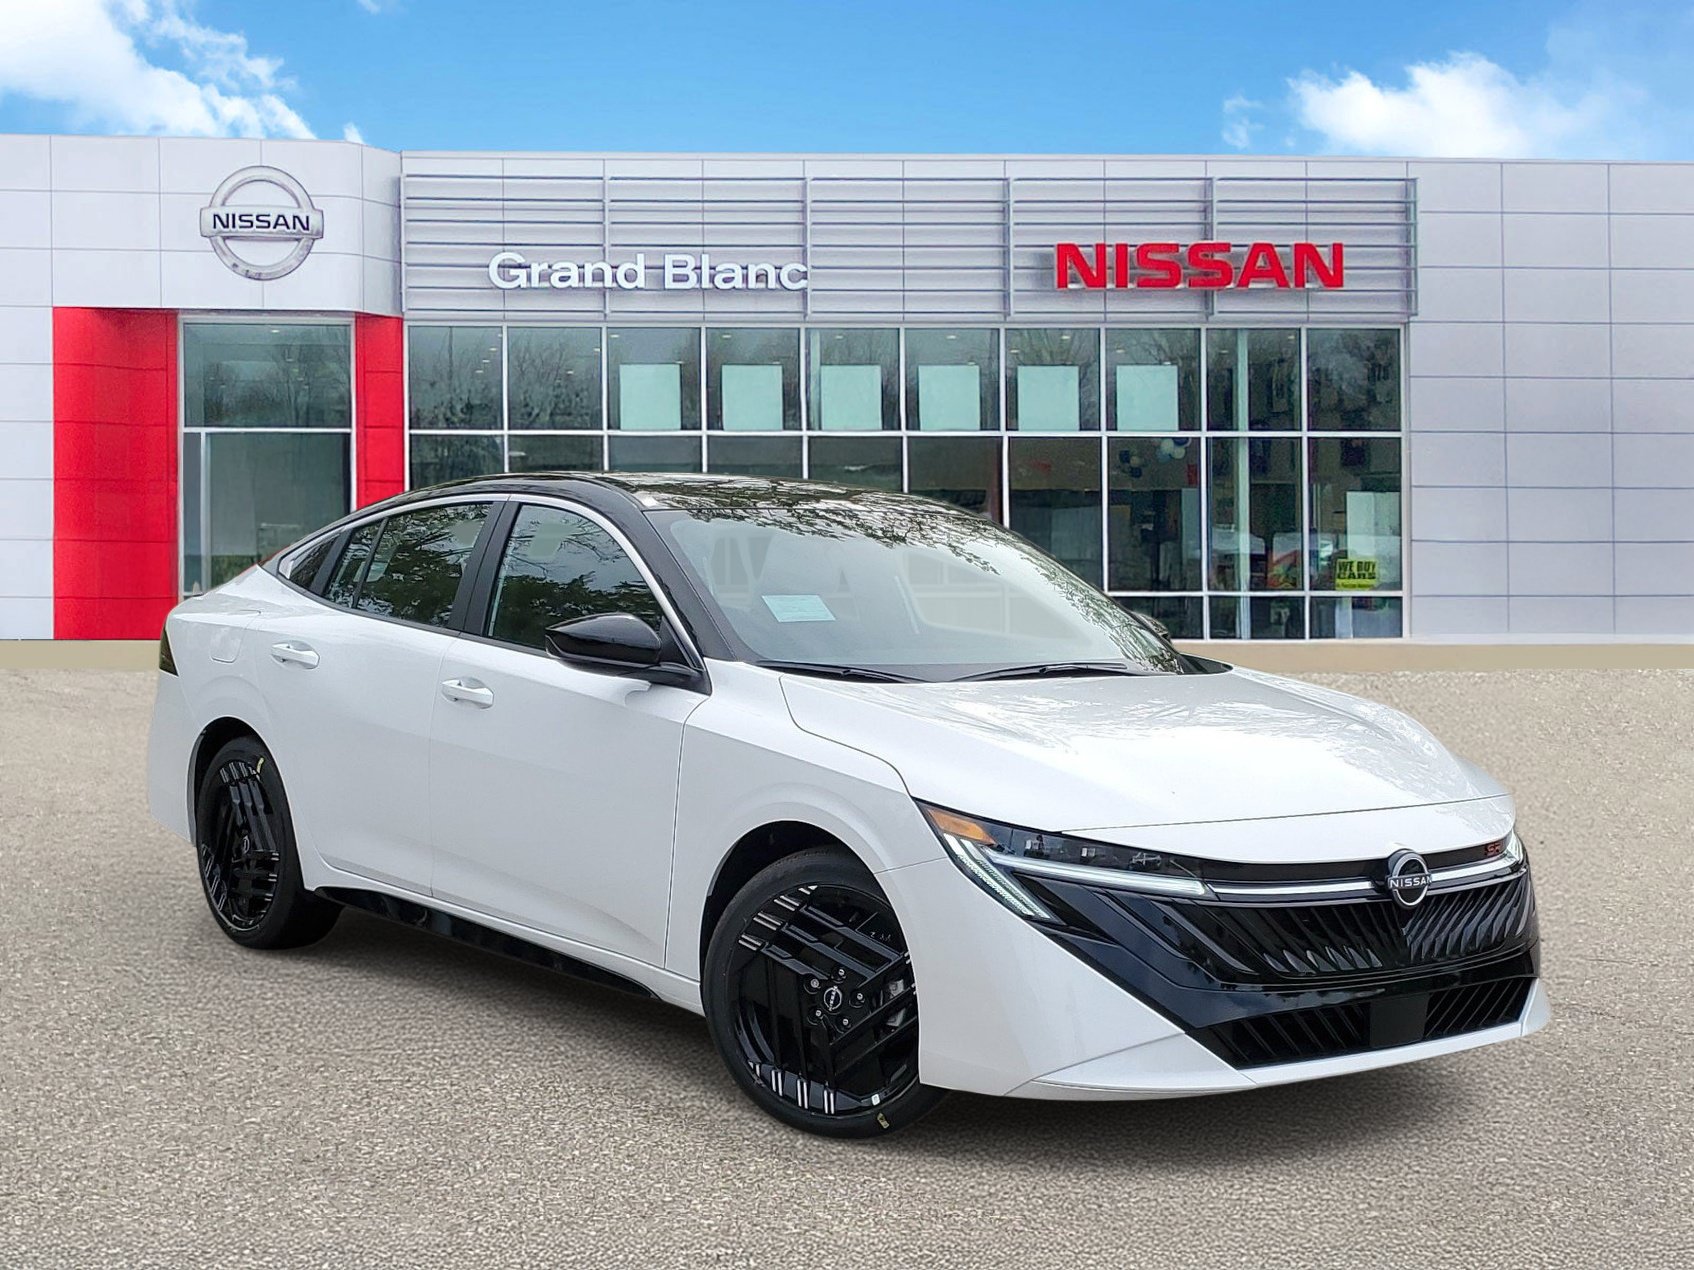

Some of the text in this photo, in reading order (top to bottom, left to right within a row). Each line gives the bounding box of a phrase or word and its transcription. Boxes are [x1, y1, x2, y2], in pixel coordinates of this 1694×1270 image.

[213, 213, 310, 231] NISSAN
[488, 252, 808, 290] Grand Blanc
[1056, 242, 1344, 289] NISSAN
[1338, 560, 1377, 572] WE BUY
[1389, 875, 1433, 888] NISSAN
